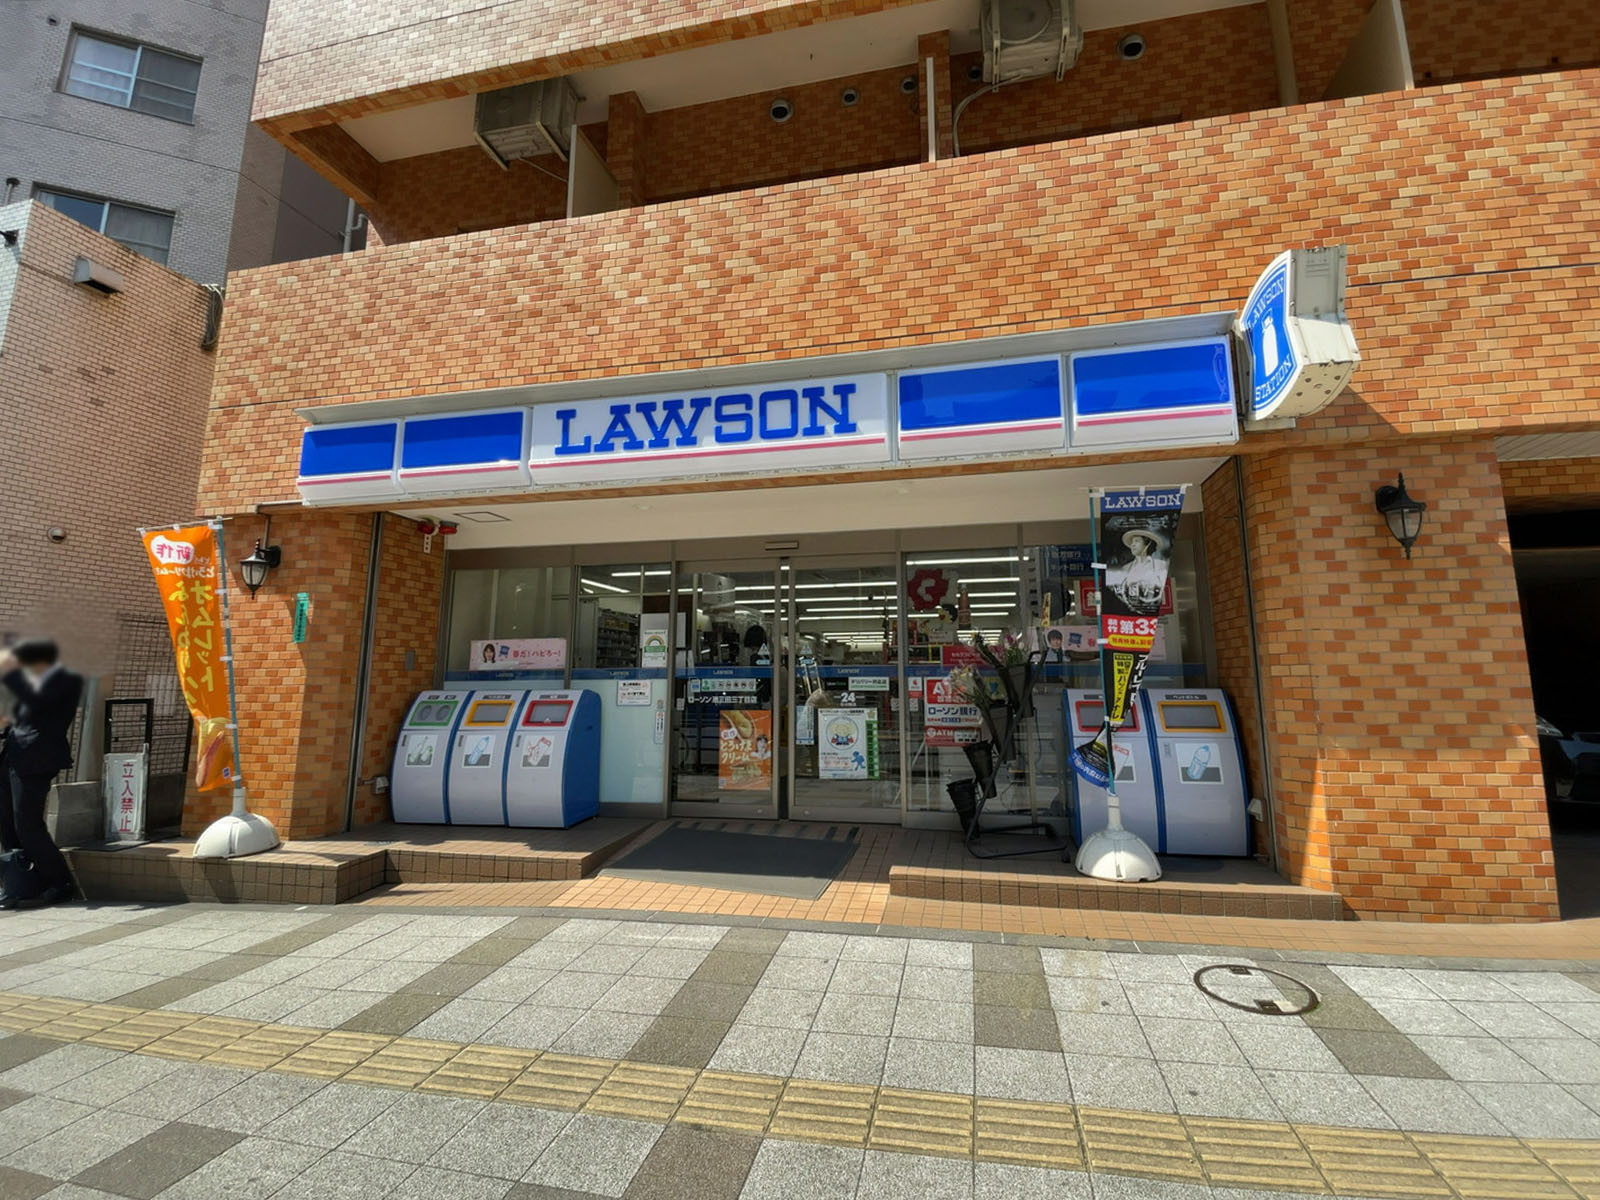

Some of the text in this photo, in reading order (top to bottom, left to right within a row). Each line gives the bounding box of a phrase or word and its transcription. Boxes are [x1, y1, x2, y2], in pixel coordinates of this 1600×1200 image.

[1248, 276, 1285, 328] LAWSON
[1255, 354, 1293, 401] STATION
[554, 383, 857, 455] LAWSON
[1105, 494, 1181, 509] LAWSON
[840, 692, 857, 703] 24
[928, 707, 977, 716] ローソン銀行
[118, 762, 134, 832] 立入禁止
